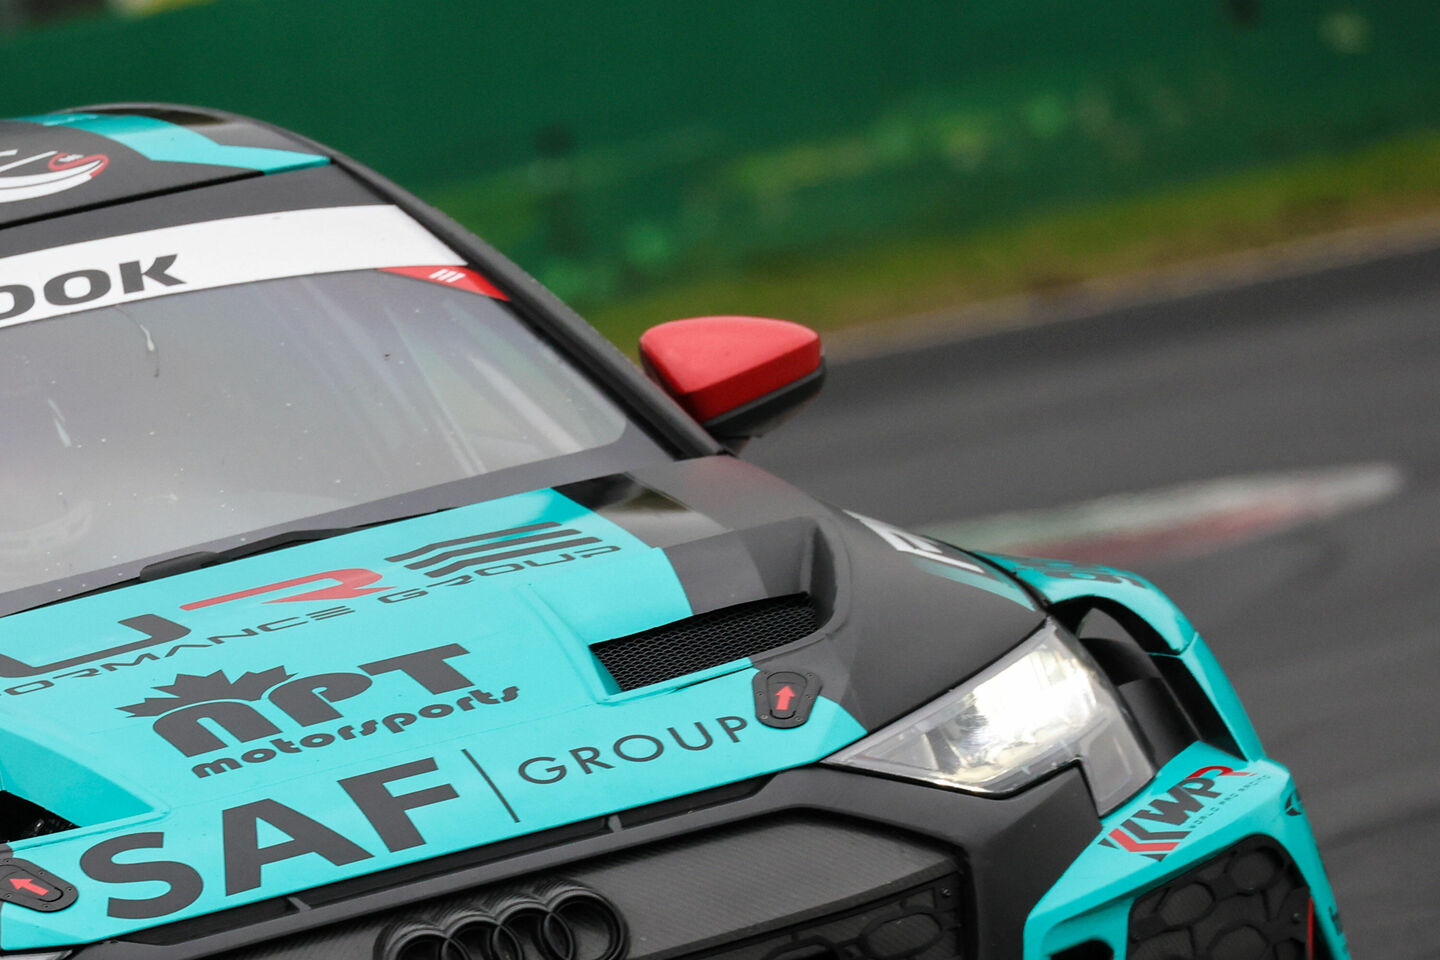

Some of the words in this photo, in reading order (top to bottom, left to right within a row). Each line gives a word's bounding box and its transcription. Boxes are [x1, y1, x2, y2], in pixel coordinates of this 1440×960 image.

[376, 544, 622, 604] GROUP
[191, 685, 521, 780] motorsports
[78, 755, 462, 921] SAF
[516, 715, 752, 786] GROUP
